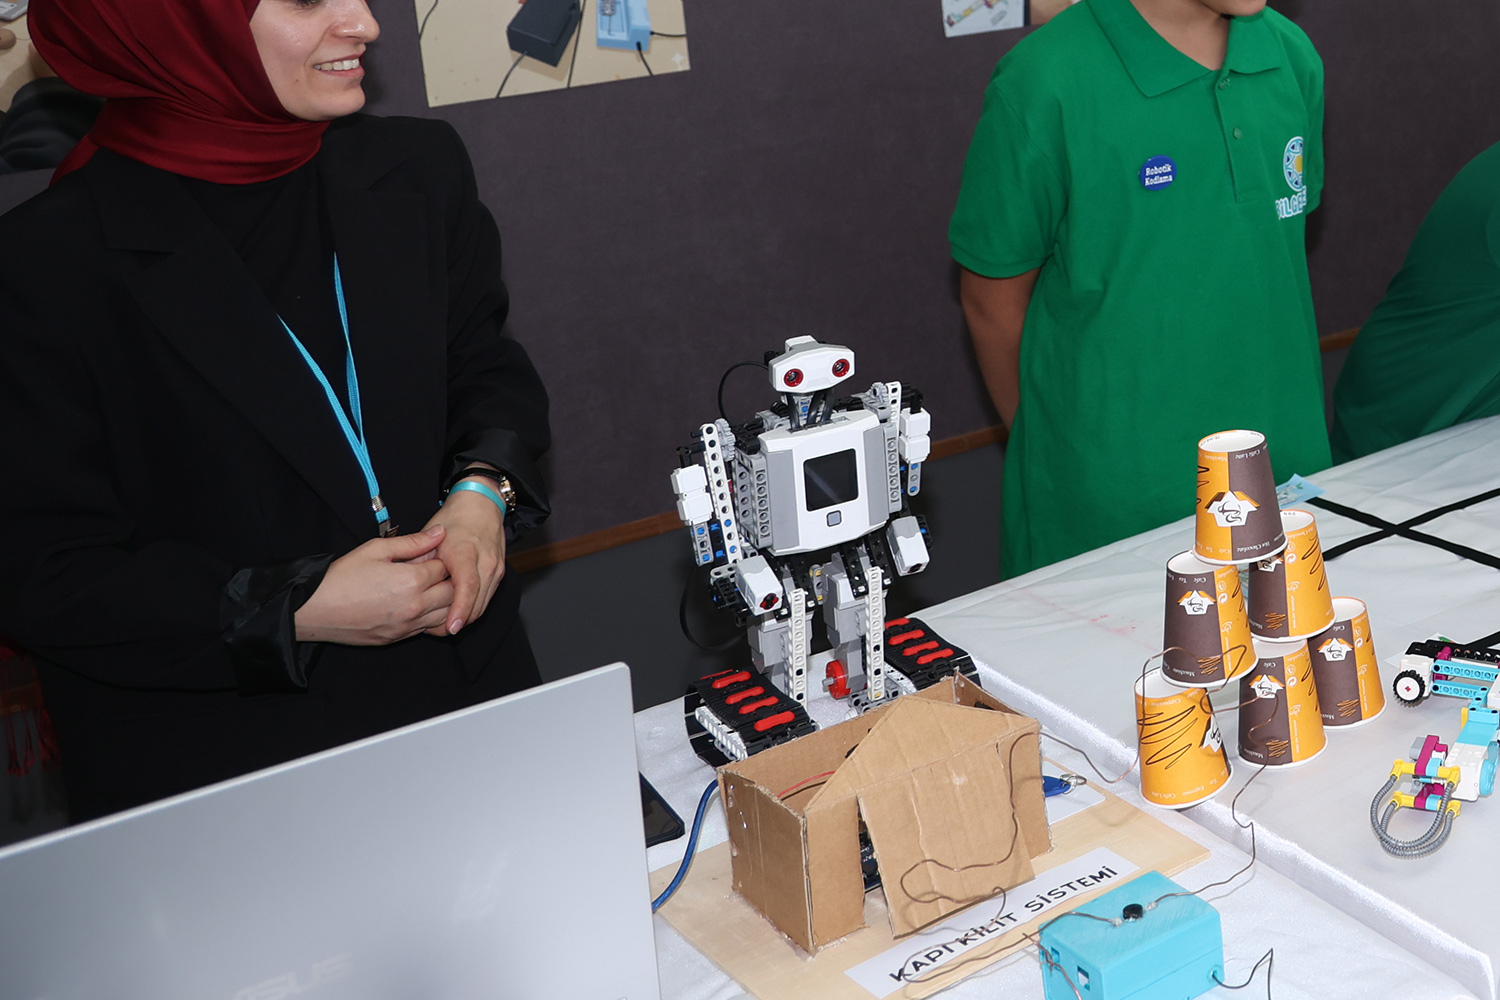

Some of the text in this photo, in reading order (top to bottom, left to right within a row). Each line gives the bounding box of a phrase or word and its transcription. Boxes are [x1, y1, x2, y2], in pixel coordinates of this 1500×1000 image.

[1145, 164, 1172, 176] Robotik
[1145, 175, 1172, 186] Kodlama
[889, 864, 1119, 982] KAPI KİLİT SİSTEMİ
